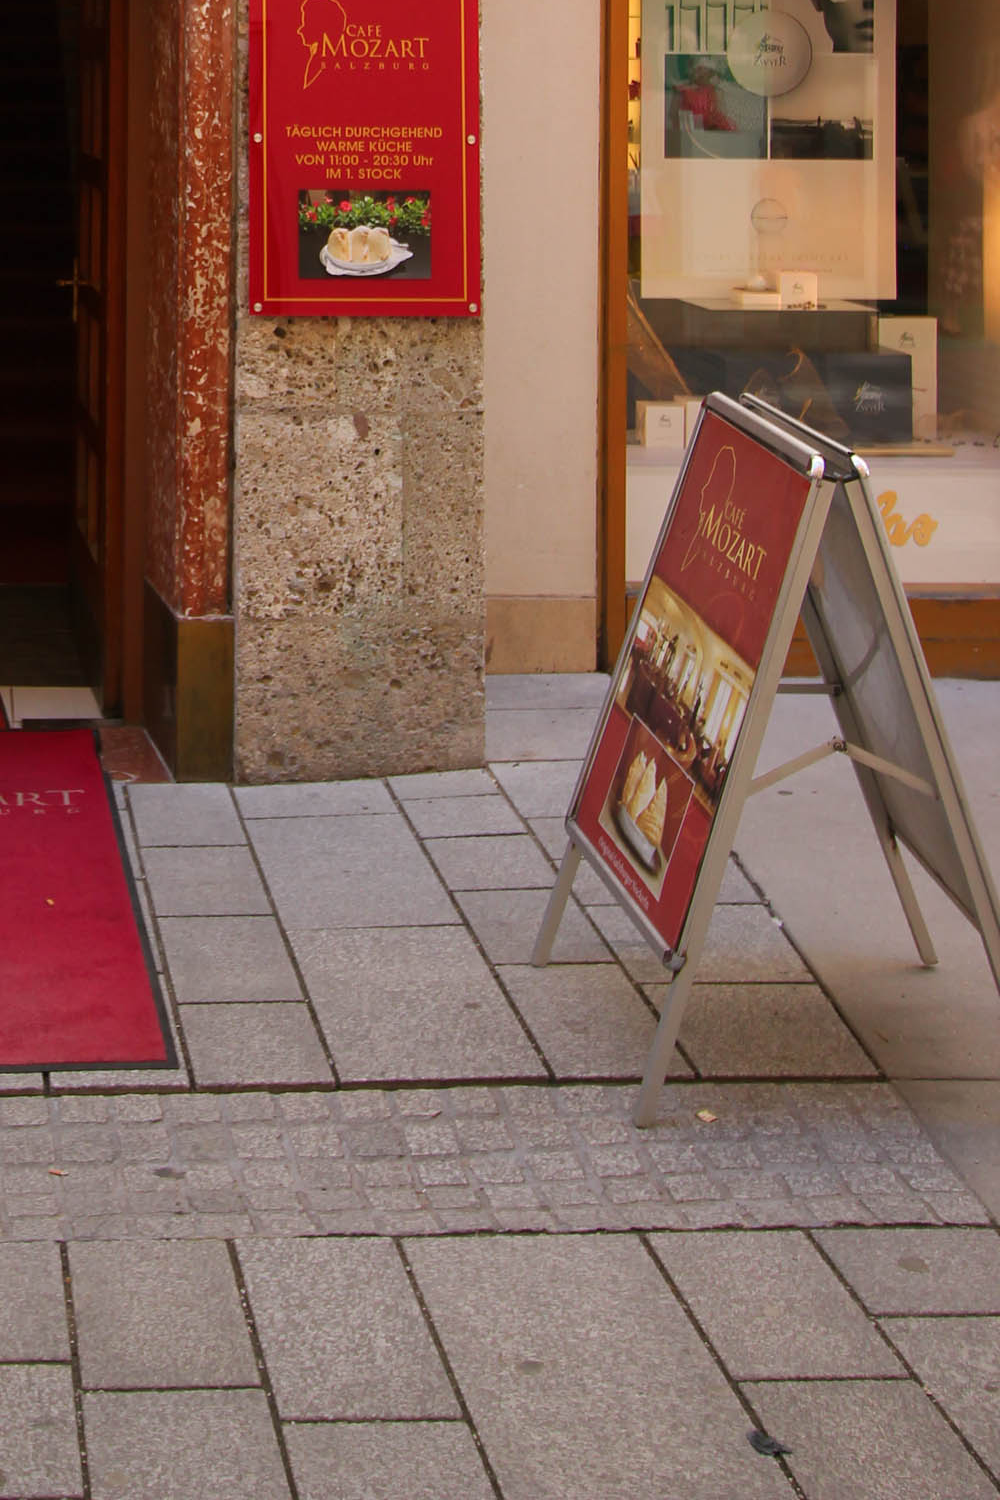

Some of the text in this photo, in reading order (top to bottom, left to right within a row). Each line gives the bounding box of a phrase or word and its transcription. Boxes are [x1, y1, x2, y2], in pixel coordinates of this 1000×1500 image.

[321, 32, 430, 58] MOZART
[285, 124, 443, 139] TÄGLICH DURCHGEHEND
[316, 139, 413, 153] WARME KÜCHE
[295, 154, 325, 166] VON
[329, 154, 360, 166] 11:00
[373, 155, 410, 167] 20:30
[413, 155, 435, 167] Uhr
[326, 168, 402, 180] IM 1. STOCK
[701, 503, 768, 581] MOZART
